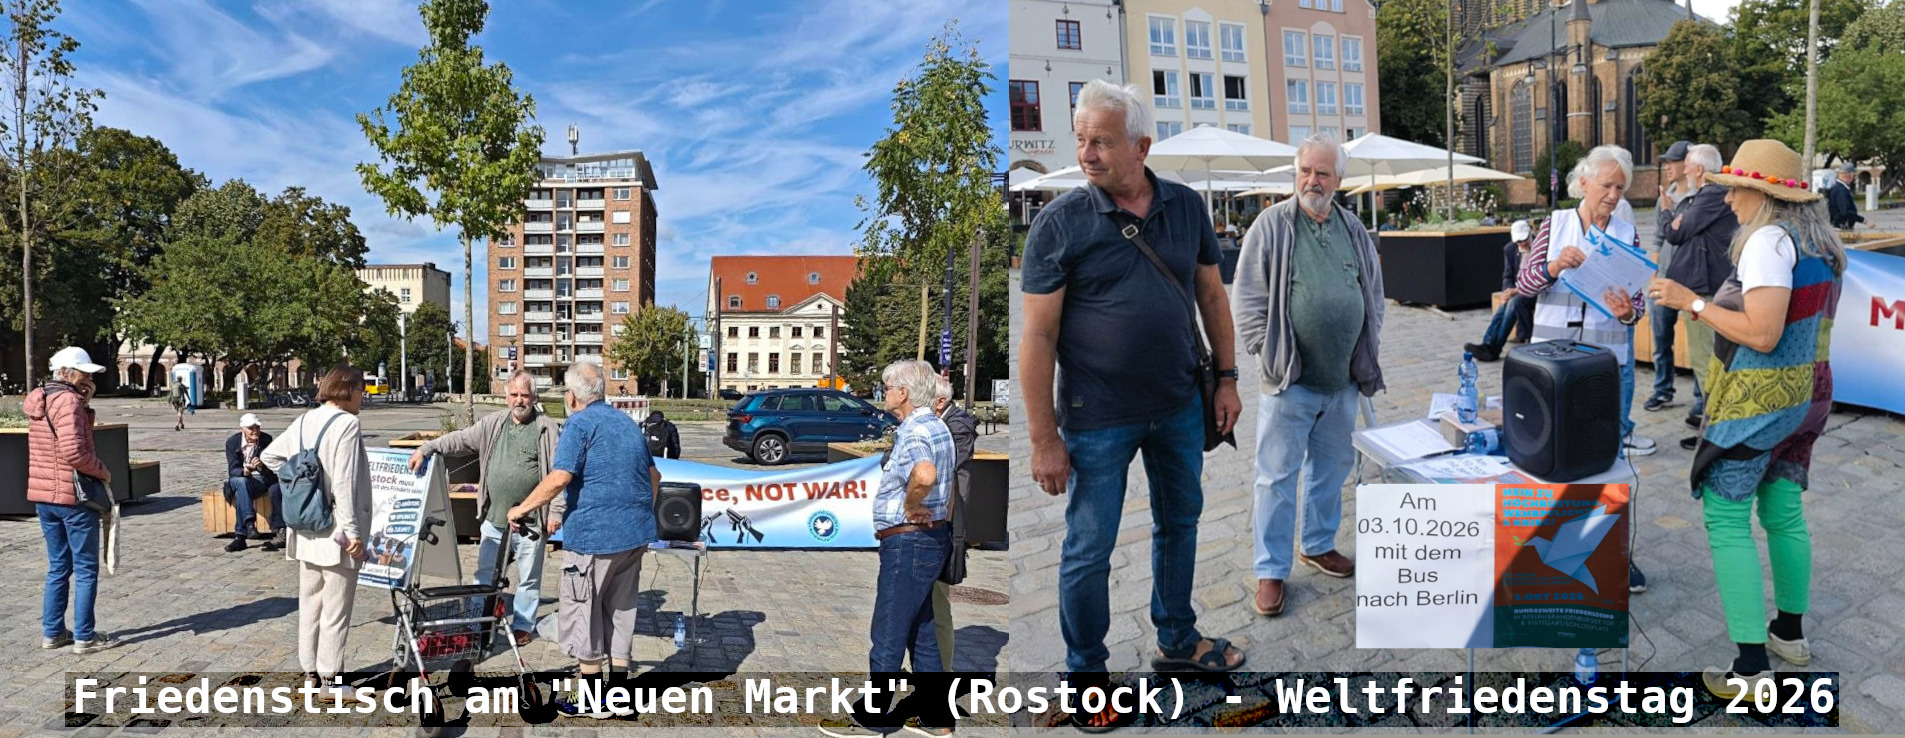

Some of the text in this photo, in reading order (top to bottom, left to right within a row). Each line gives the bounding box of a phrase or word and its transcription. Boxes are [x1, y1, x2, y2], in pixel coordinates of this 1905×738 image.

[745, 482, 797, 501] NOT
[802, 480, 867, 500] WAR!
[1502, 488, 1553, 498] NEIN ZU
[1399, 492, 1437, 511] Am
[1358, 517, 1480, 537] 03.10.2026
[1513, 518, 1555, 527] KRIEG!
[1375, 543, 1462, 561] mit dem
[1398, 568, 1439, 584] Bus
[1356, 590, 1478, 607] nach Berlin
[1553, 592, 1585, 601] 2026
